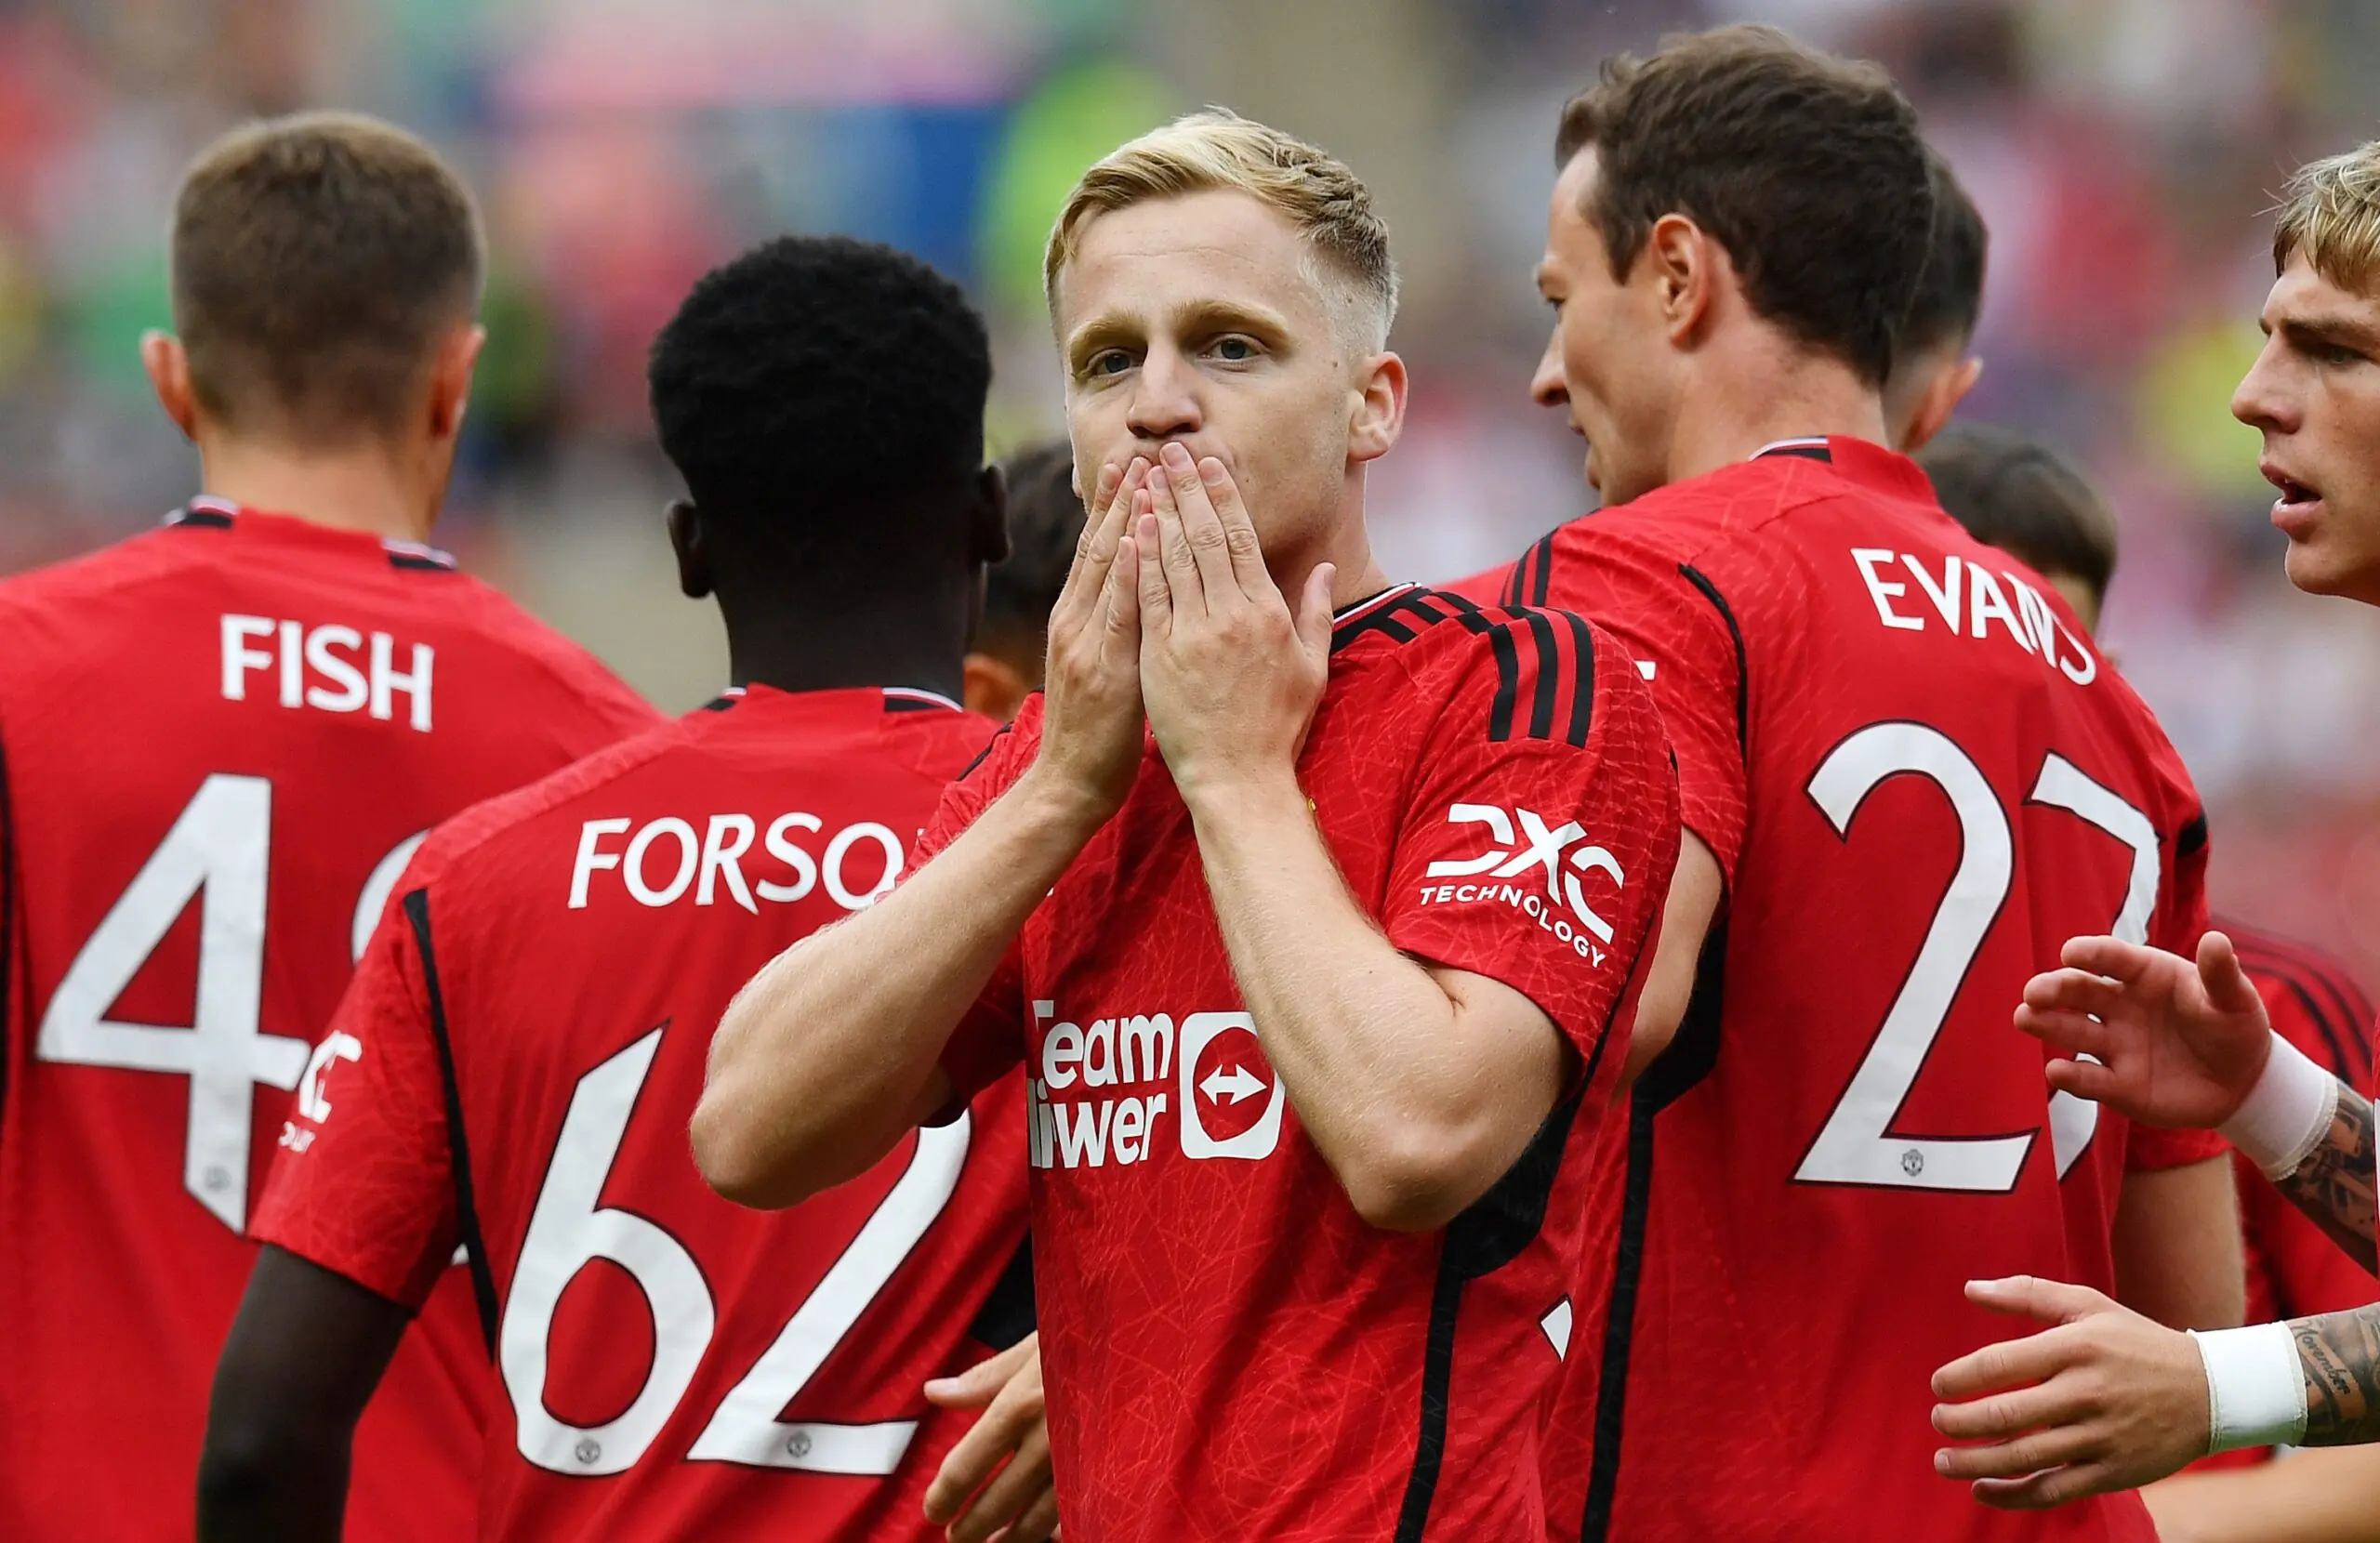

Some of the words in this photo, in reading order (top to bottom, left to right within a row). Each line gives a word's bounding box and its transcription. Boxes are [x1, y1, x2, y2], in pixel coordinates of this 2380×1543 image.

[219, 613, 434, 732] FISH
[1849, 547, 2096, 685] EVANS
[566, 811, 928, 916] FORSO
[1420, 884, 1606, 969] TECHNOLOGY
[1425, 803, 1625, 945] DXC
[35, 772, 433, 1236] 4
[497, 1019, 972, 1478] 62
